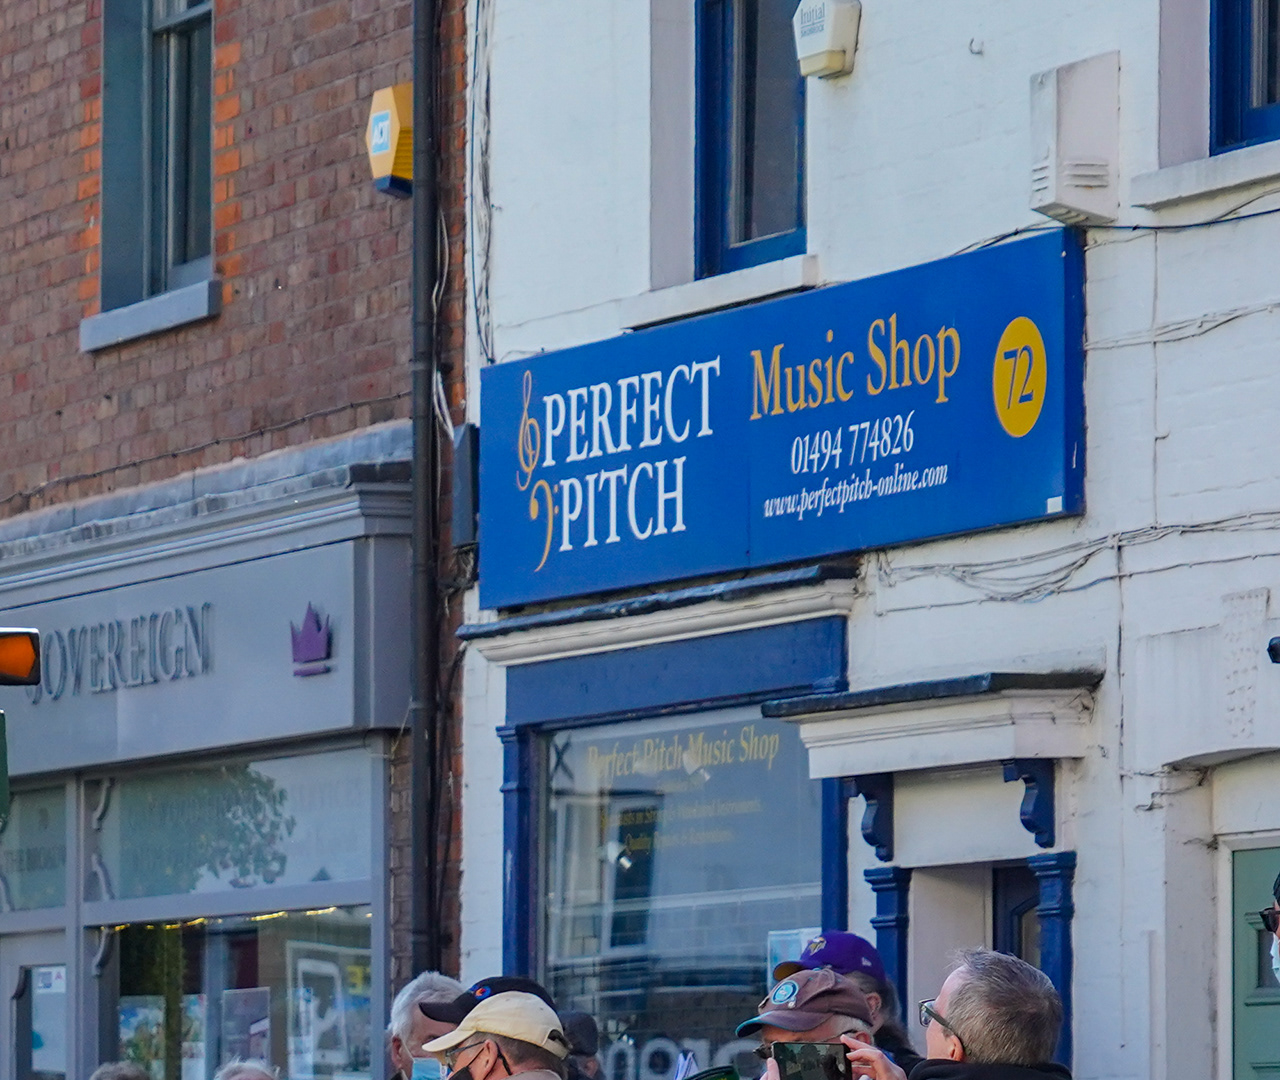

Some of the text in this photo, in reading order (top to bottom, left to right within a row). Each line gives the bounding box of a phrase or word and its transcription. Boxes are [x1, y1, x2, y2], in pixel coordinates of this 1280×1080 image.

[800, 2, 825, 25] Initial
[750, 312, 960, 421] Music Shop
[1002, 343, 1034, 411] 72
[542, 355, 720, 468] PERFECT
[791, 409, 915, 475] 01494 774826
[559, 458, 687, 553] PITCH
[763, 461, 948, 521] www.perfectpitch-online.com
[25, 601, 215, 705] OVEREIGN
[589, 724, 780, 788] Perfect Pitch Music Shop
